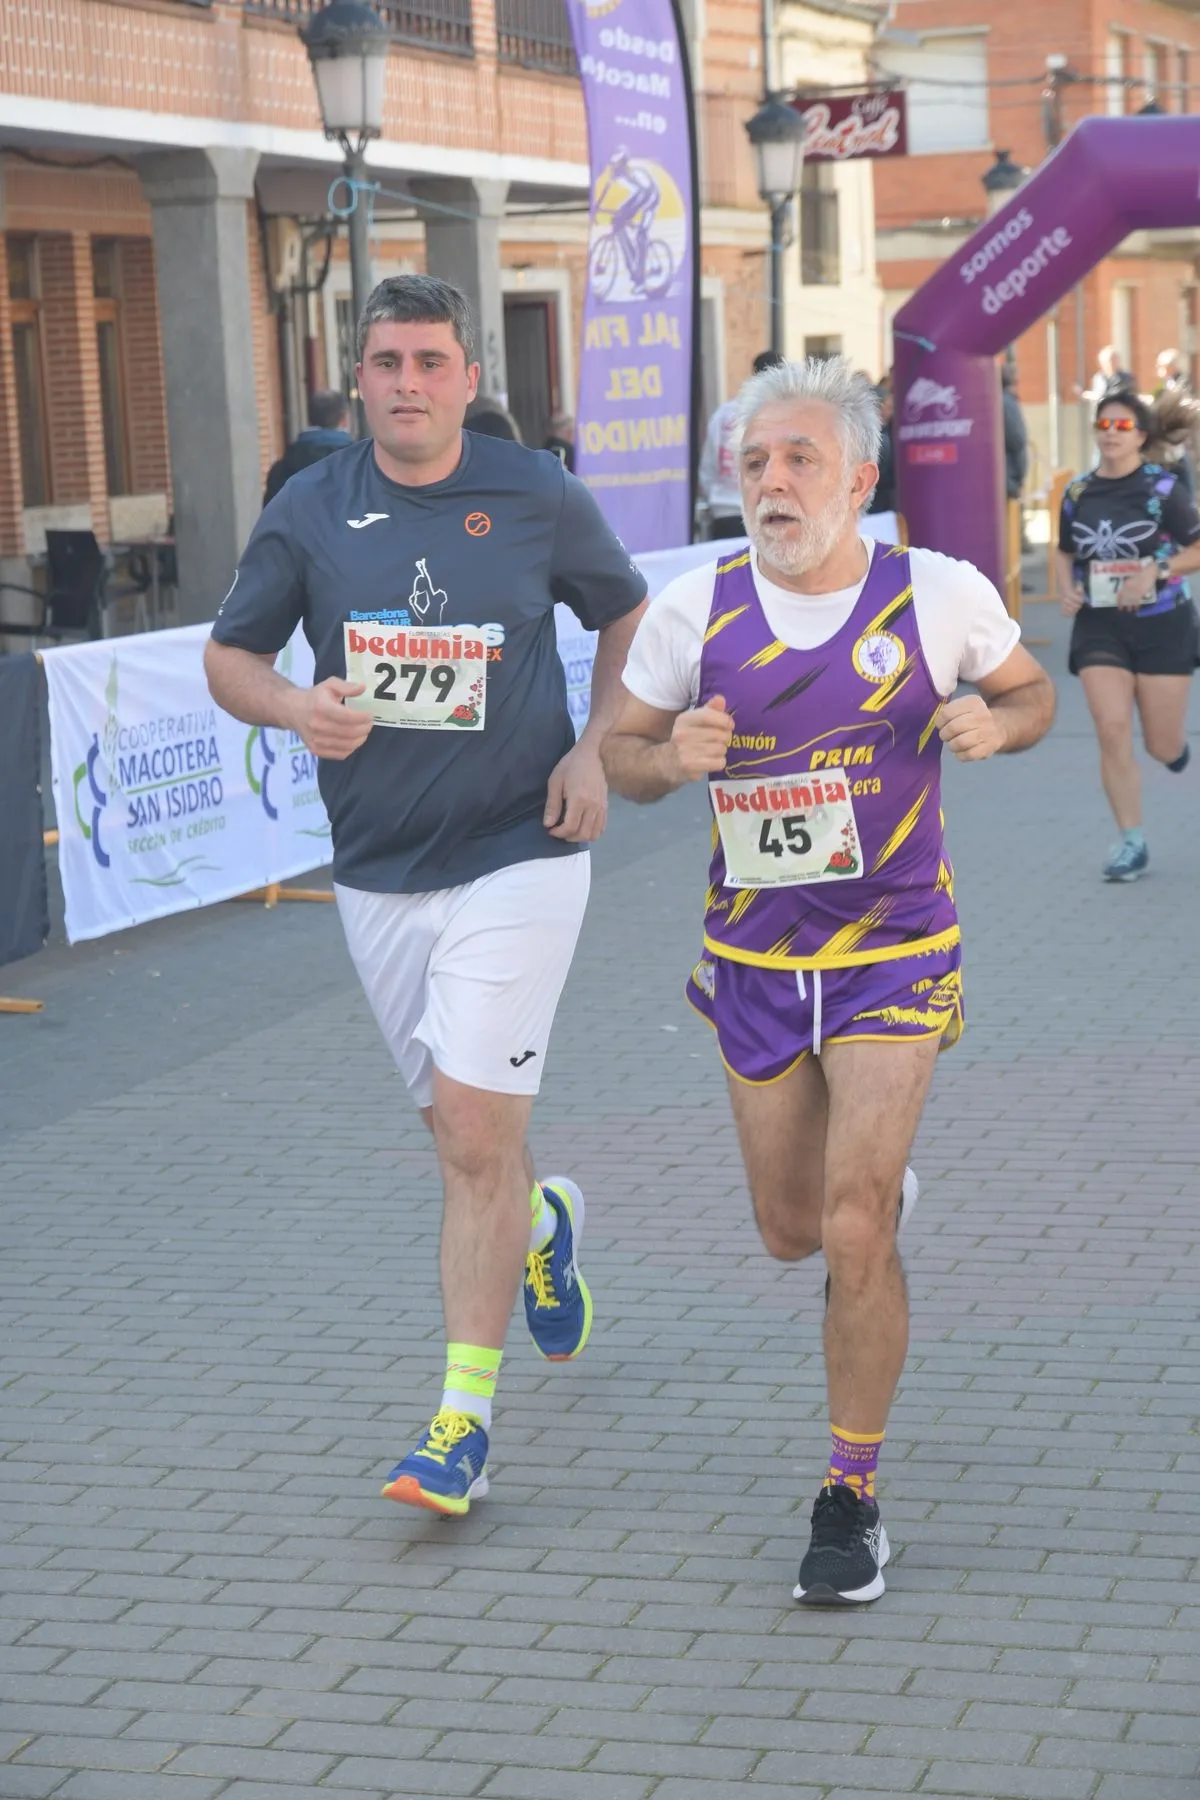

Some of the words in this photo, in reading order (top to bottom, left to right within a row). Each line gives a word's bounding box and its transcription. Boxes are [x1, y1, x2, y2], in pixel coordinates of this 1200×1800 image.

[959, 206, 1034, 284] somos
[980, 226, 1073, 315] deporte
[350, 609, 408, 621] Barcelona
[348, 629, 484, 660] bedunia
[373, 662, 456, 703] 279
[117, 708, 218, 752] COOPERATIVA
[118, 735, 221, 788] MACOTERA
[809, 744, 876, 771] PRIM
[126, 796, 161, 829] SAN
[166, 776, 224, 820] ISIDRO
[715, 778, 847, 814] bedunia
[844, 776, 882, 797] tera
[758, 814, 812, 858] 45
